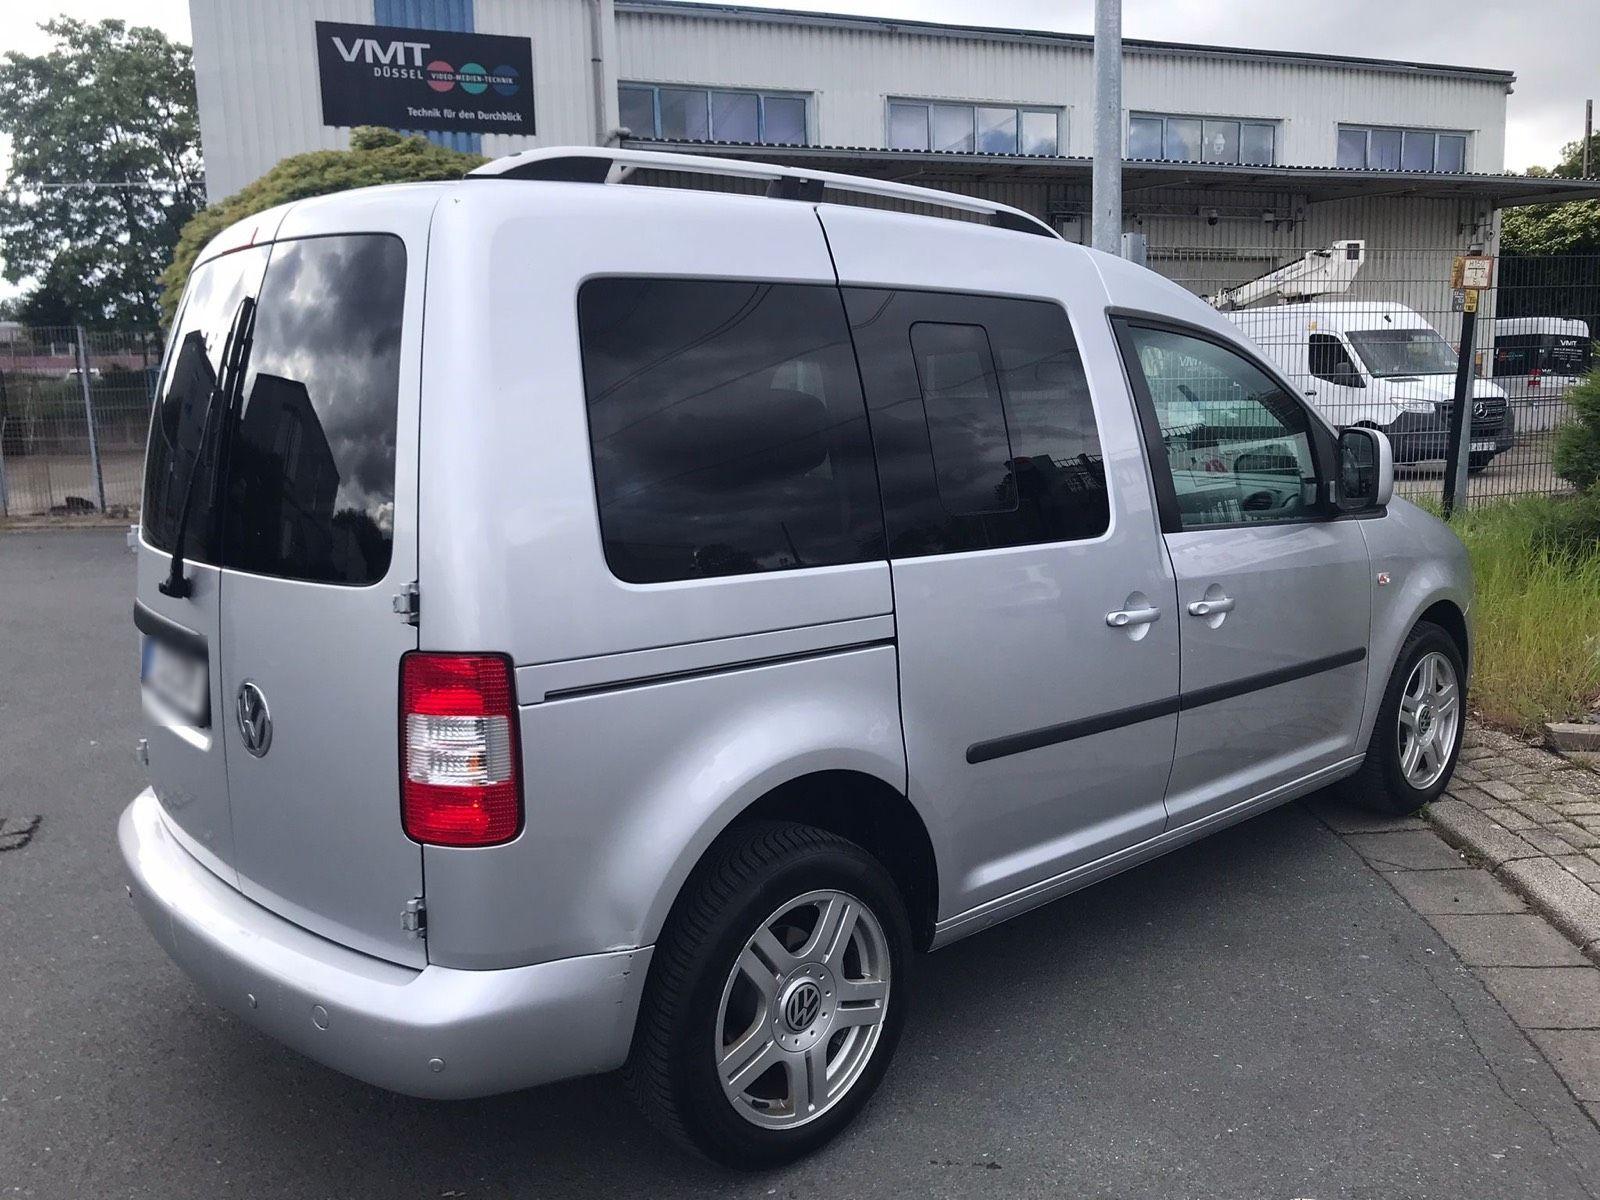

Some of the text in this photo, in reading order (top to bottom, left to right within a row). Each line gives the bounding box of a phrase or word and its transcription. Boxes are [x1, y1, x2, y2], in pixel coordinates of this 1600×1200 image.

[331, 37, 430, 66] VMT
[374, 66, 423, 79] DÜSSEL
[407, 107, 522, 122] Technik für den Durchblick
